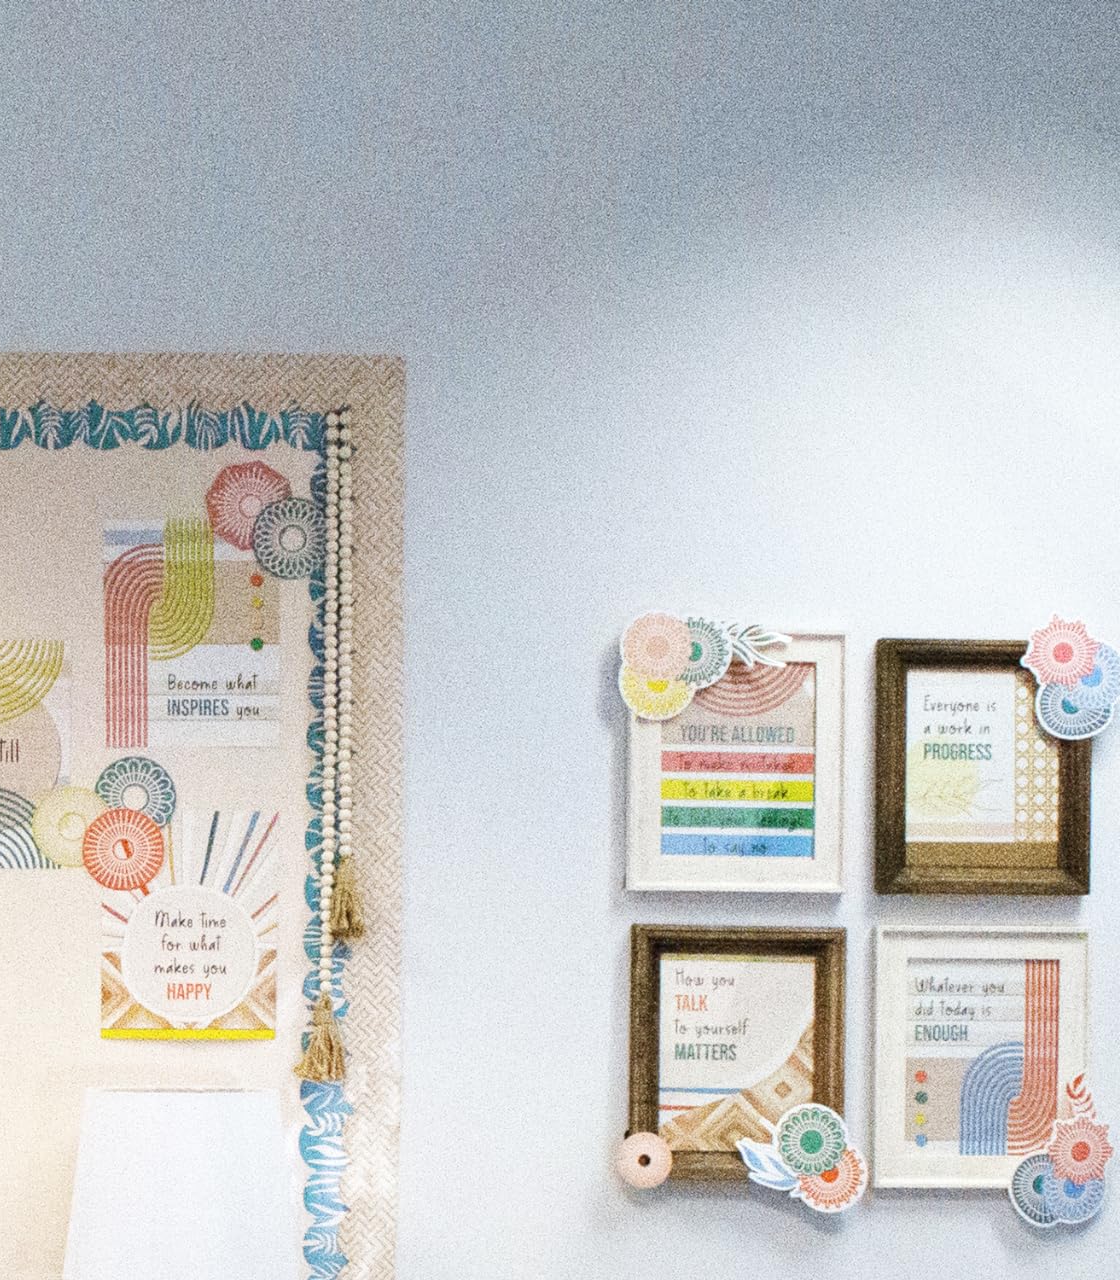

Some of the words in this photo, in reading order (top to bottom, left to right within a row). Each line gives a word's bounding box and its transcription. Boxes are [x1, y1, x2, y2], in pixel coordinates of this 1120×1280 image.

[167, 673, 218, 690] Become
[226, 673, 258, 690] what
[167, 698, 229, 716] INSPIRES
[236, 705, 260, 720] you
[923, 694, 980, 717] Everyone
[987, 701, 997, 712] is
[680, 724, 729, 742] YOU'RE
[731, 725, 796, 743] ALLOWED
[923, 725, 931, 735] a
[938, 717, 972, 735] work
[979, 725, 991, 735] in
[923, 743, 992, 760] PROGRESS
[154, 910, 193, 928] Make
[201, 911, 227, 928] time
[161, 933, 182, 951] for
[189, 934, 221, 951] what
[154, 957, 195, 975] makes
[203, 966, 227, 979] you
[674, 967, 705, 987] How
[712, 976, 735, 991] you
[914, 975, 975, 993] Whatever
[982, 983, 1005, 997] you
[166, 983, 212, 1001] HAPPY
[674, 993, 709, 1012] TALK
[914, 1000, 934, 1016] did
[981, 1005, 992, 1017] is
[695, 1017, 749, 1039] yourself
[914, 1024, 969, 1041] ENOUGH
[674, 1043, 737, 1061] MATTERS
